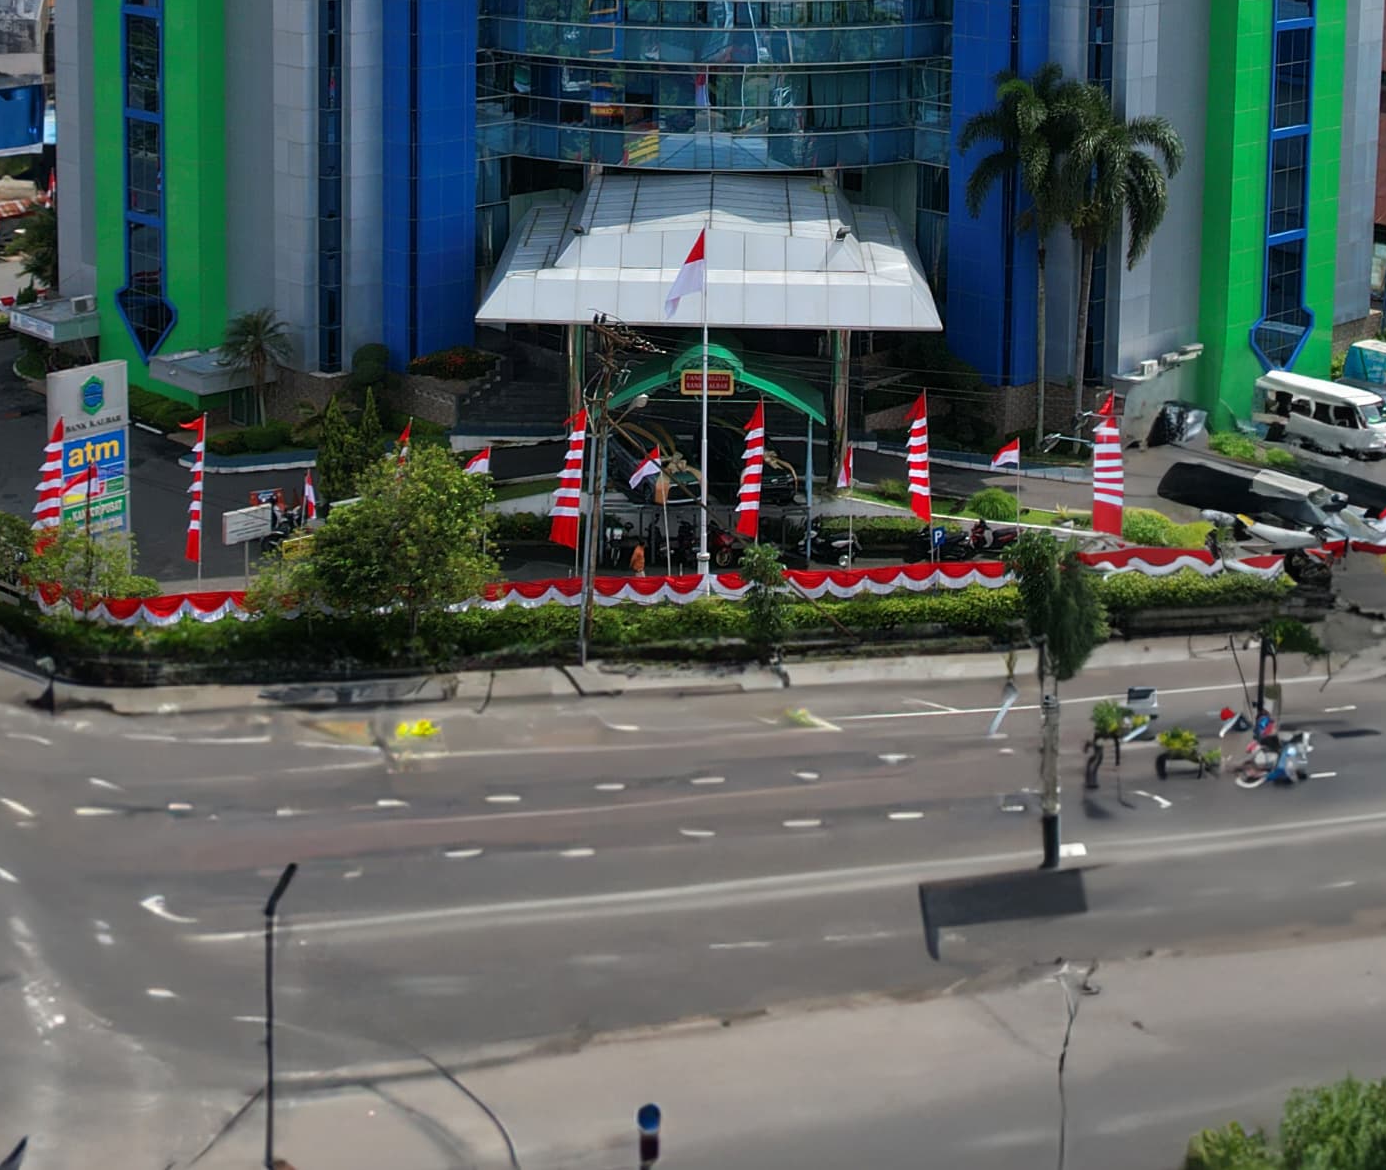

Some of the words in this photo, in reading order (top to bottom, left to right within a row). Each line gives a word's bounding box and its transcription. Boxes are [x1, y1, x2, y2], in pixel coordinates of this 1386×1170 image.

[65, 423, 87, 432] BANK
[89, 415, 121, 427] KALBAR
[68, 439, 119, 468] atm
[72, 506, 101, 520] KANOR
[935, 530, 943, 543] P
